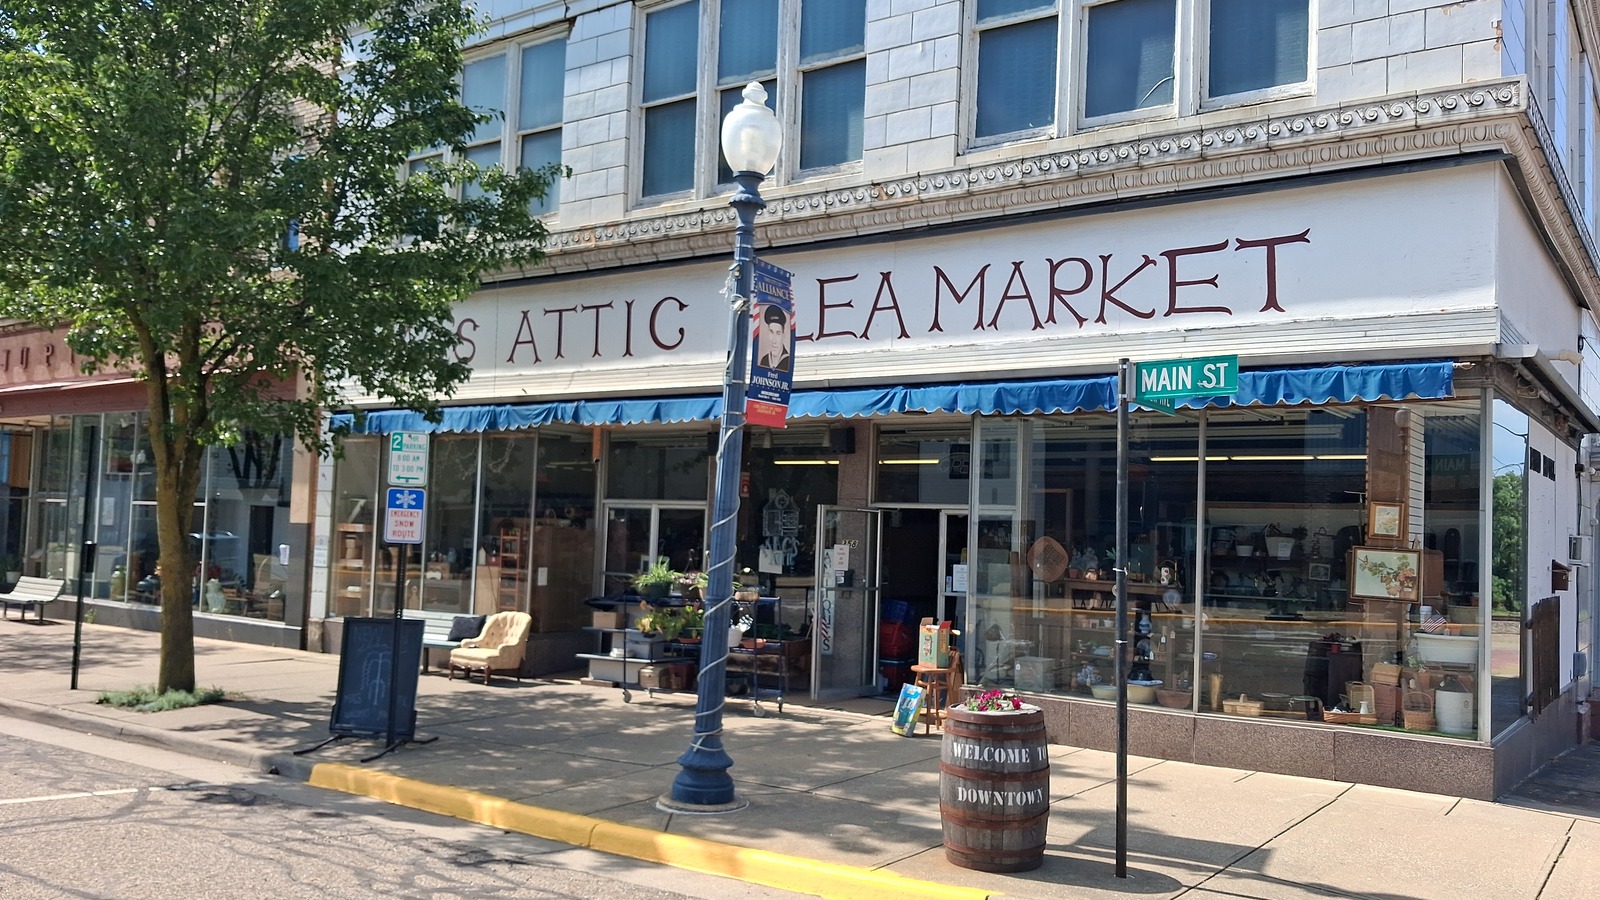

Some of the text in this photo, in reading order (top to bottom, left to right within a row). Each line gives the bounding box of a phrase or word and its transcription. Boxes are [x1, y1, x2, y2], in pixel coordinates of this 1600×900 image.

[507, 297, 690, 364] ATTIC
[927, 227, 1312, 333] MARKET
[751, 375, 781, 388] JOHNSON
[1141, 362, 1229, 392] MAIN ST
[393, 435, 402, 449] 2
[391, 510, 419, 518] EMERGENCY
[953, 741, 1030, 763] WELCOME
[957, 786, 1043, 806] DOWNTOWN
